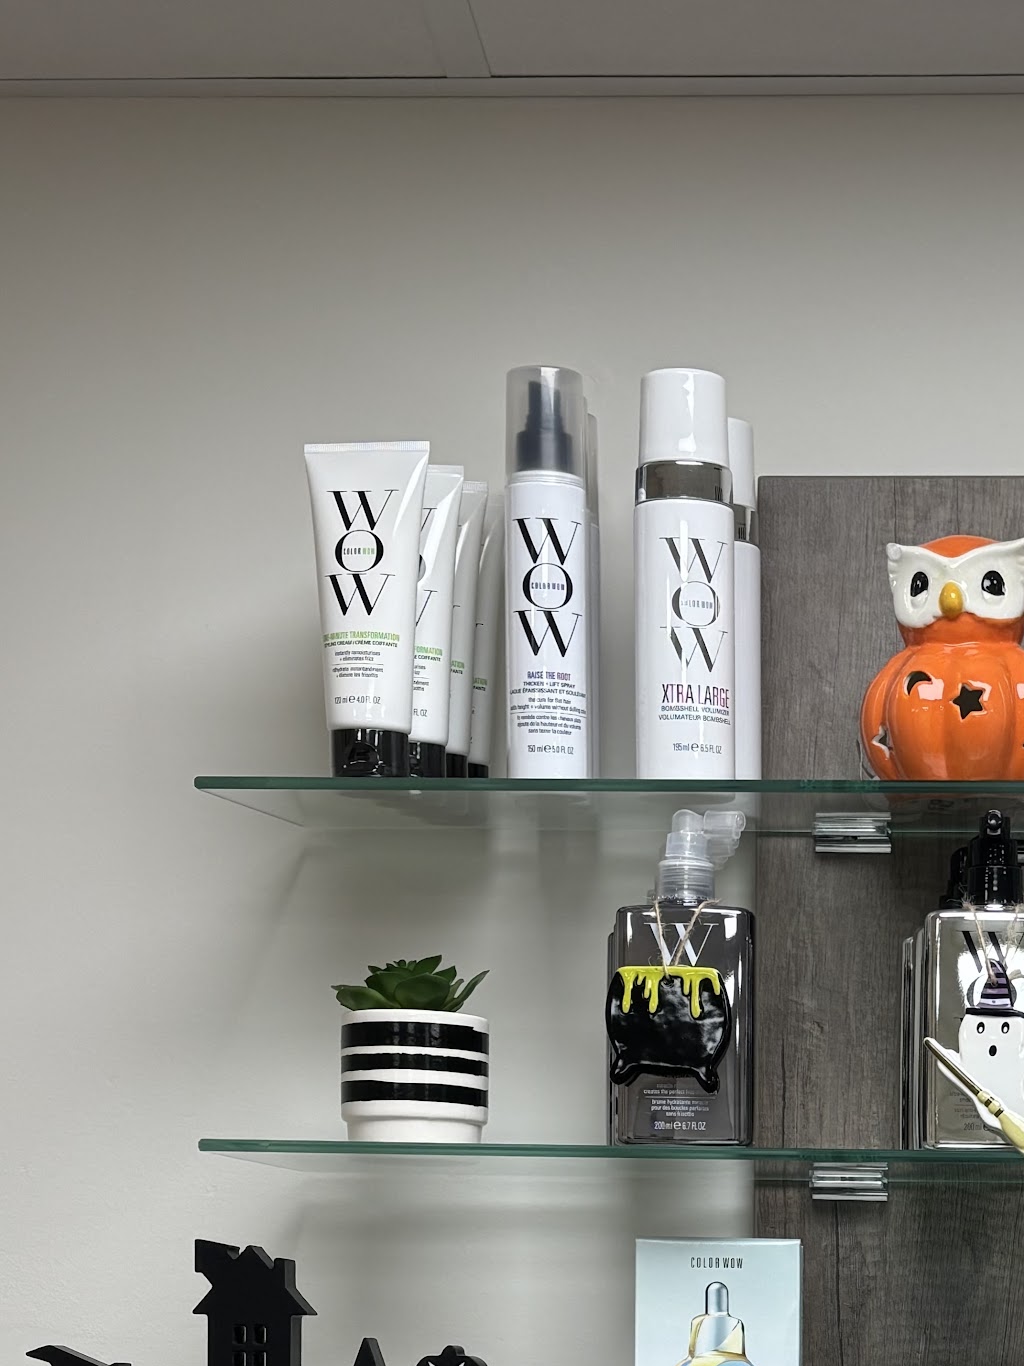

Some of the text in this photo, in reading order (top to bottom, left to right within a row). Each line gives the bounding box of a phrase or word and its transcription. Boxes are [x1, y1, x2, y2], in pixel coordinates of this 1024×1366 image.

[324, 489, 399, 617] WOW
[512, 517, 582, 658] WOW
[659, 537, 728, 673] WOW
[546, 672, 556, 680] THE
[661, 683, 730, 709] XTRA LARGE
[690, 1257, 744, 1270] COLOR WOW
